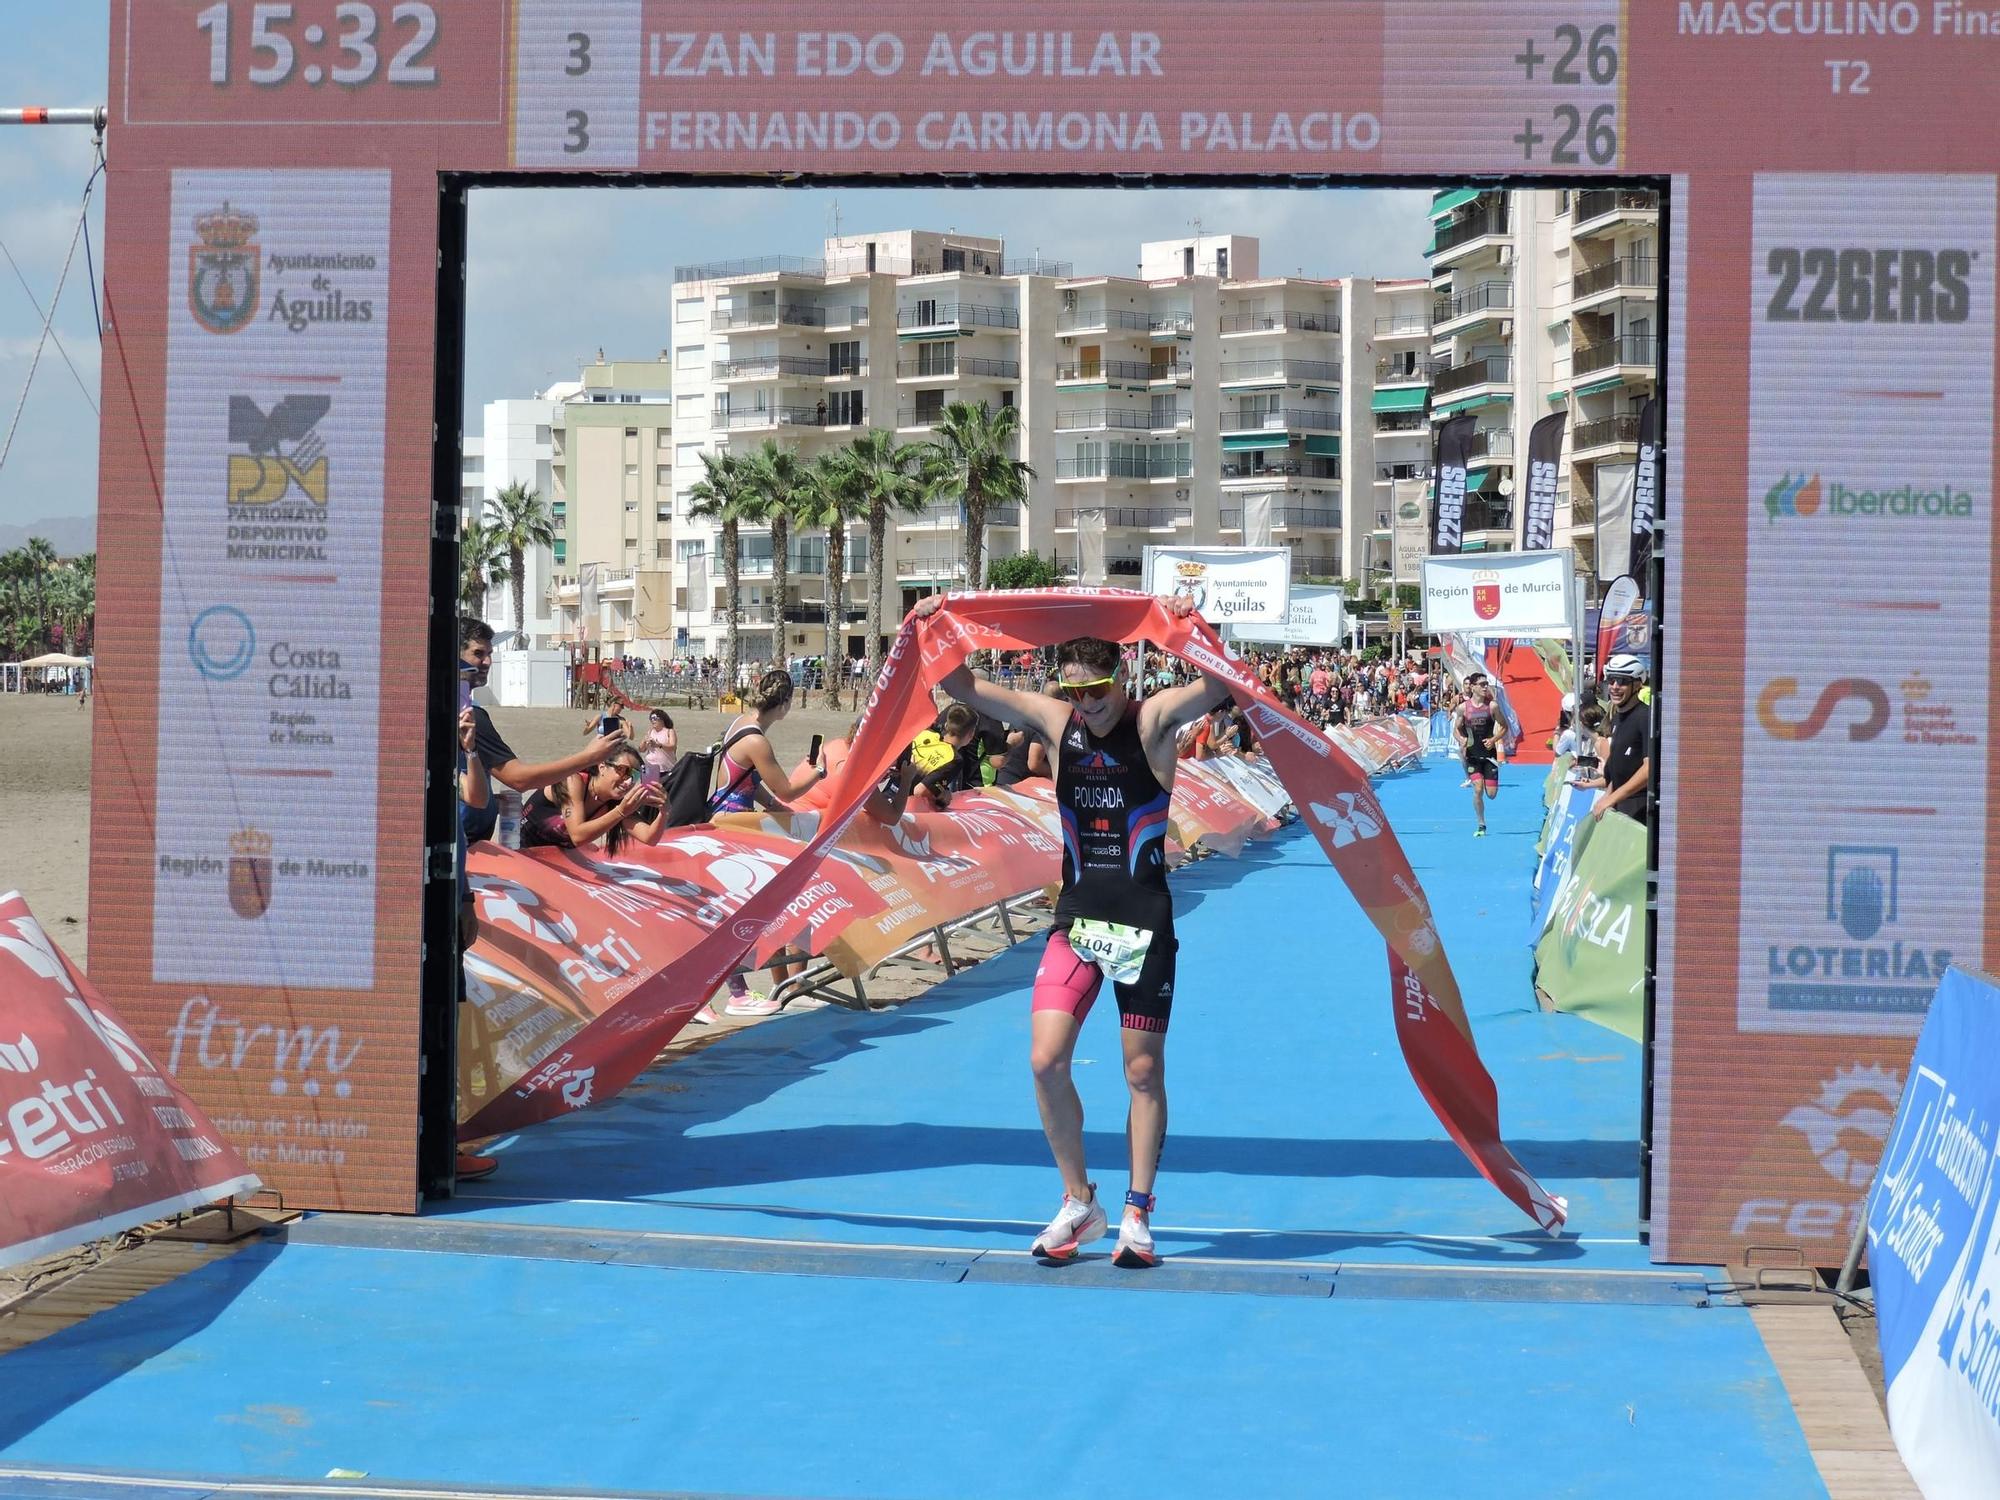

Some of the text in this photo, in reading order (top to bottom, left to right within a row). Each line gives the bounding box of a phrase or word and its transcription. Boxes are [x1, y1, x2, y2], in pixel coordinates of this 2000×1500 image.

[1678, 2, 1920, 35] MASCULINO
[197, 2, 438, 84] 15:32
[565, 33, 591, 76] 3
[650, 32, 1163, 76] IZAN EDO AGUILAR
[1515, 24, 1618, 86] +26
[1824, 60, 1871, 94] T2
[563, 110, 590, 153] 3
[646, 110, 1381, 152] FERNANDO CARMONA PALACIO
[1514, 104, 1617, 164] +26
[268, 252, 376, 274] Ayuntamiento
[311, 273, 331, 292] de
[1766, 248, 1970, 323] 226ERS
[267, 288, 373, 333] Águilas
[227, 507, 328, 523] PATRONATO
[1438, 465, 1466, 547] 226ERS
[1527, 461, 1556, 549] 226ERS
[227, 525, 328, 541] DEPORTIVO
[227, 544, 328, 560] MUNICIPAL
[1213, 579, 1267, 589] Ayuntamiento
[1235, 589, 1245, 597] de
[1428, 580, 1561, 600] Región de Murcia
[1213, 596, 1265, 616] Águilas
[269, 641, 341, 668] Costa
[1194, 650, 1215, 665] CON
[1215, 661, 1229, 673] EL
[268, 673, 351, 700] Cálida
[1074, 786, 1125, 808] POUSADA
[160, 854, 369, 878] Región de Murcia
[1072, 935, 1113, 956] 4104
[1767, 940, 1952, 978] LOTERÍAS
